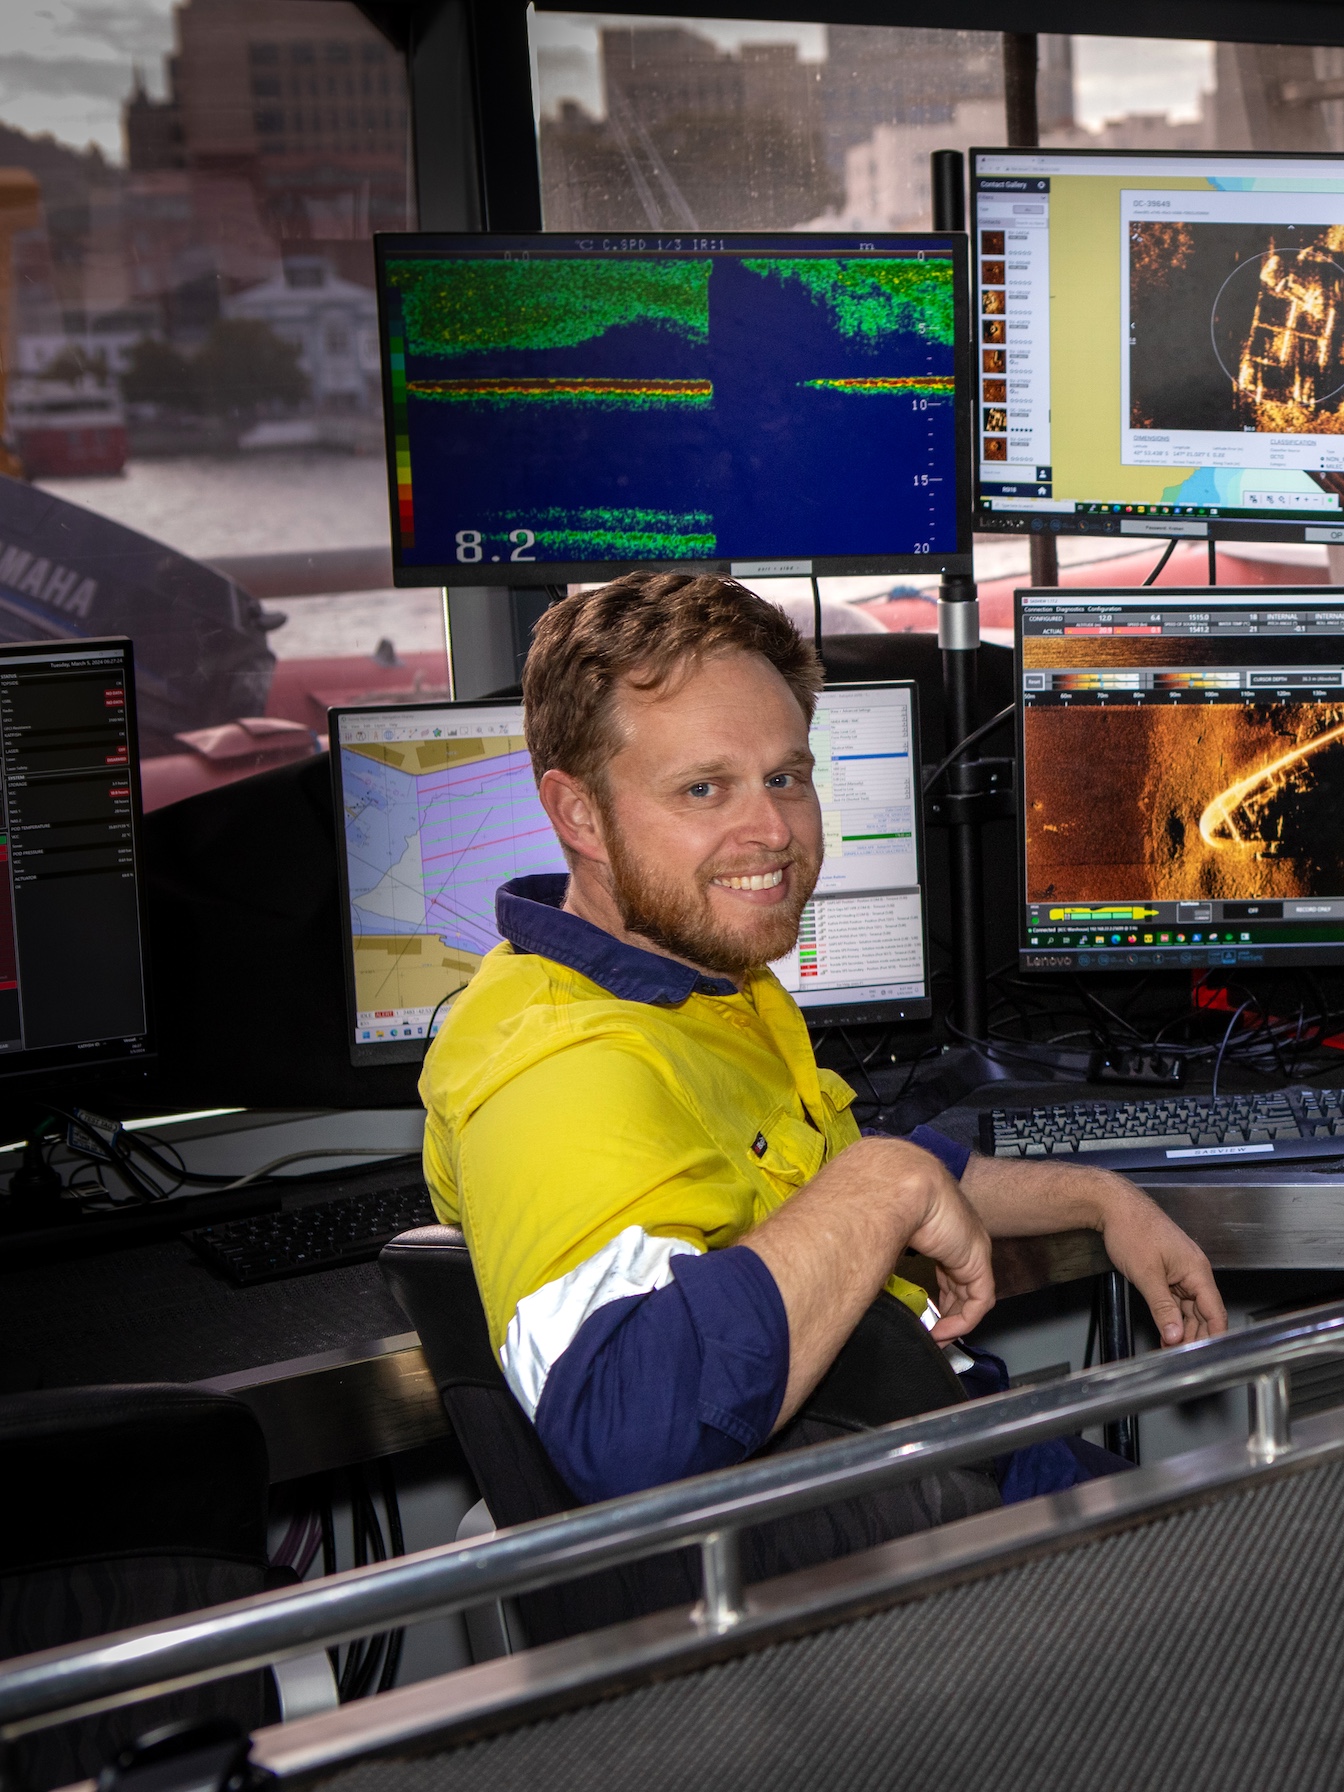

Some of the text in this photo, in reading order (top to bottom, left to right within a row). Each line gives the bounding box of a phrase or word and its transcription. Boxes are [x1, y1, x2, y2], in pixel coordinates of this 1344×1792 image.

[657, 239, 682, 250] 1/3
[693, 239, 724, 250] IR:1
[504, 251, 530, 262] 0.0
[918, 323, 926, 334] 5
[912, 399, 927, 411] 10
[913, 474, 929, 486] 15
[455, 529, 536, 563] 8.2
[914, 543, 930, 554] 20
[0, 540, 98, 619] MAHA
[1026, 955, 1072, 966] Lenovo
